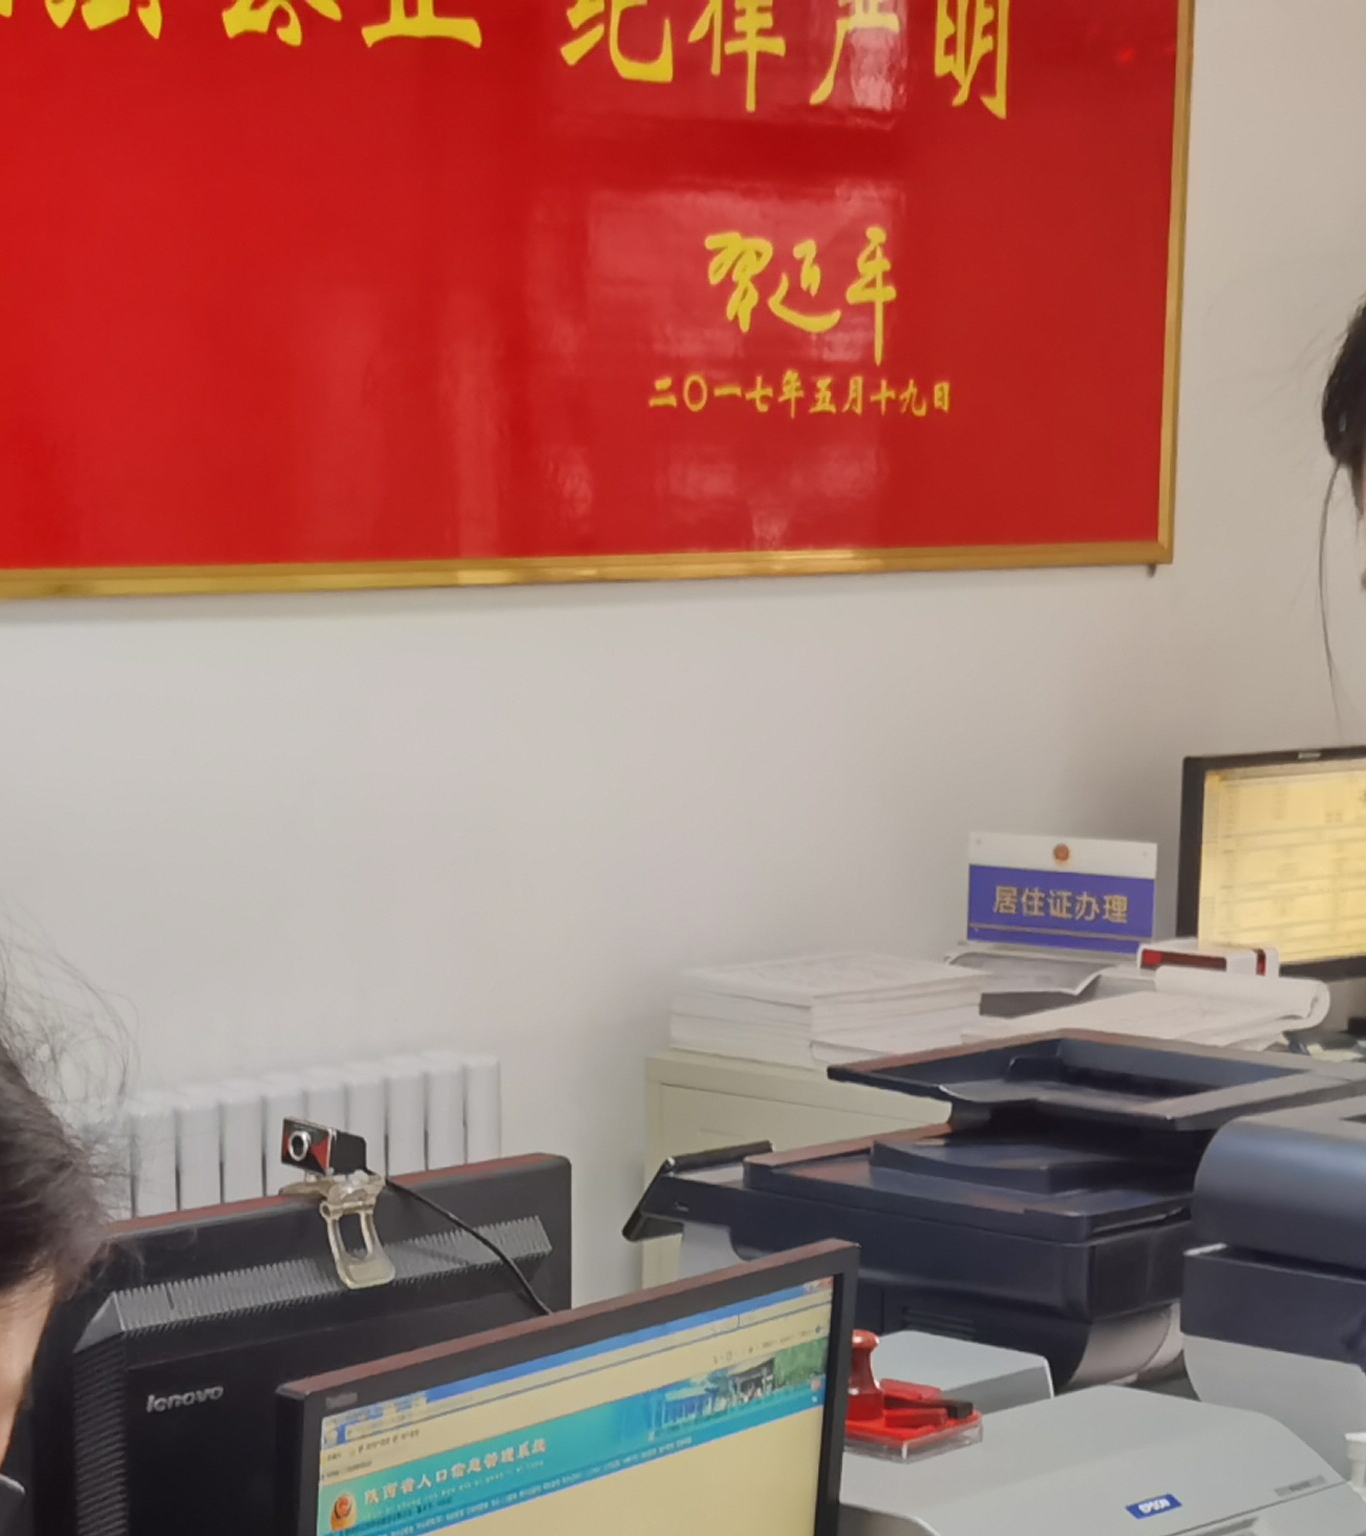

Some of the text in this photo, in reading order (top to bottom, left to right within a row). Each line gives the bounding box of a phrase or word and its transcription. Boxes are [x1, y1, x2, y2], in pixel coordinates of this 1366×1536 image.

[992, 885, 1129, 924] 居住证办理
[146, 1384, 225, 1414] lenovo
